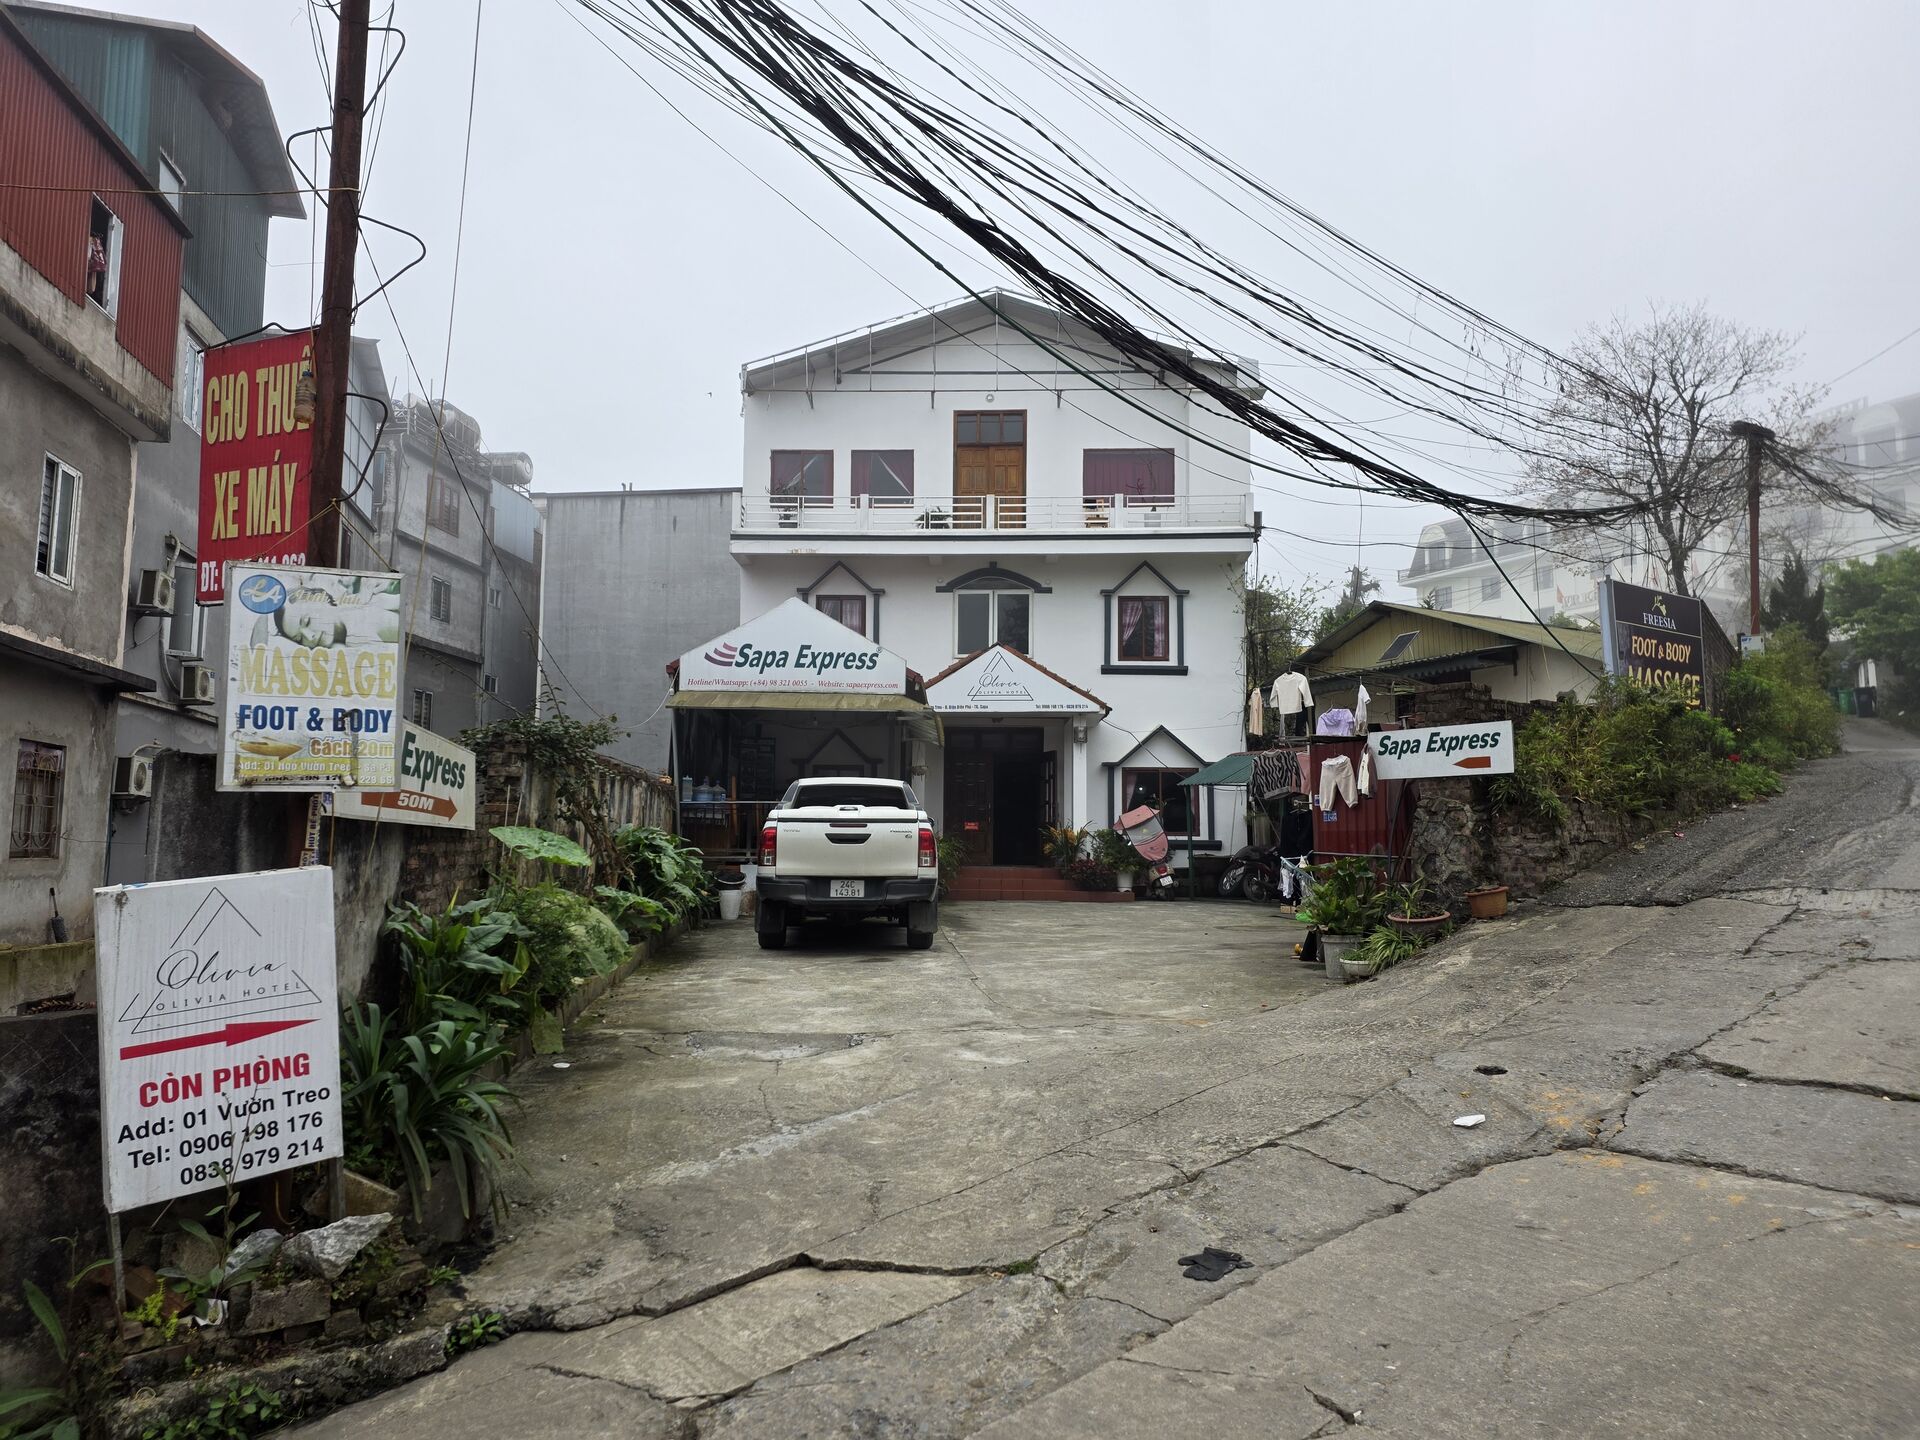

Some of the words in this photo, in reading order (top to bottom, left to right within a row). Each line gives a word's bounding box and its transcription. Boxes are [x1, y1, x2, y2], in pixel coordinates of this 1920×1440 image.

[205, 370, 249, 445] CHO
[211, 470, 240, 540] XE
[246, 449, 298, 536] MÁY
[1642, 612, 1677, 630] FREESIA
[734, 643, 789, 674] Sapa
[794, 645, 880, 675] Express
[1631, 635, 1657, 659] FOOT
[1665, 642, 1691, 664] BODY
[238, 643, 397, 699] MASSAGE
[687, 678, 748, 687] Hotline/Whatsapp:
[750, 679, 768, 687] (+84)
[818, 680, 844, 688] Website:
[846, 681, 899, 689] sapaexpress.com
[979, 672, 1021, 688] Olivia
[239, 704, 299, 731] FOOT
[306, 707, 324, 731] &
[333, 708, 392, 733] BODY
[310, 736, 352, 757] Cách
[1378, 735, 1421, 760] Sapa
[1426, 732, 1501, 757] Express
[401, 730, 466, 792] Express
[397, 793, 434, 811] 50M
[834, 889, 861, 897] 143.81
[840, 880, 855, 889] 24C
[156, 949, 288, 990] Olivia
[155, 994, 227, 1011] OLIVIA
[243, 982, 301, 996] HOTEL
[139, 1071, 203, 1108] CÒN
[213, 1053, 310, 1094] PHÒNG
[117, 1117, 174, 1144] Add:
[183, 1108, 207, 1129] 01
[282, 1087, 330, 1108] Treo
[128, 1146, 171, 1169] Tel:
[179, 1131, 234, 1157] 0906
[242, 1120, 279, 1143] 198
[287, 1111, 323, 1133] 176
[180, 1158, 234, 1185] 0838
[241, 1147, 280, 1170] 979
[287, 1137, 324, 1160] 214
